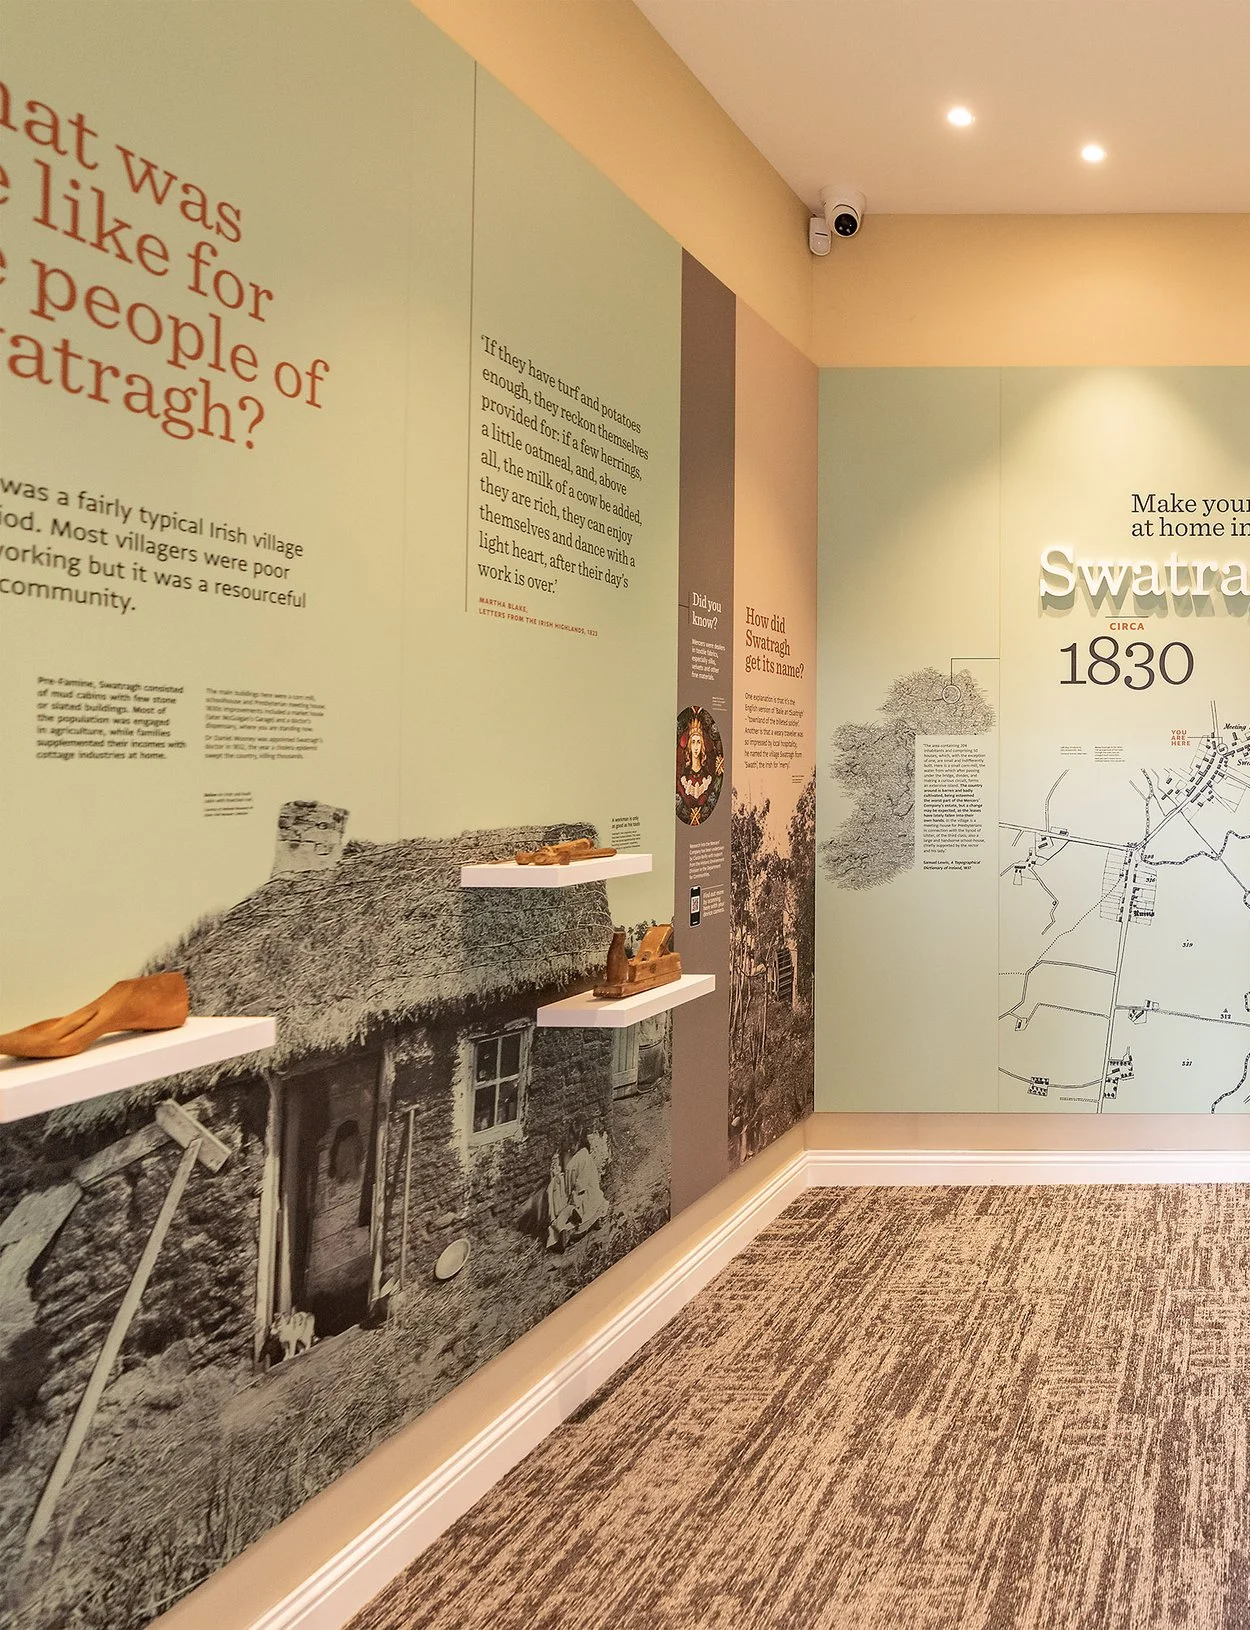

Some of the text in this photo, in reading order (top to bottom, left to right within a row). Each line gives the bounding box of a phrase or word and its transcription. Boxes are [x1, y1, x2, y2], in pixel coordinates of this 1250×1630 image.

[116, 144, 242, 242] was
[32, 158, 274, 322] like for
[30, 256, 260, 382] people
[274, 358, 330, 410] of
[0, 326, 266, 450] atragh?
[481, 334, 641, 434] 'If they have turf and potatoes
[482, 368, 648, 460] enough, they reckon themselves
[481, 395, 642, 482] provided for: if a few herrings,
[481, 422, 627, 496] a little oatmeal, and, above
[0, 478, 304, 560] was a fairly typical Irish village
[1131, 492, 1197, 513] Make
[1132, 520, 1154, 537] at
[1159, 516, 1225, 537] home
[50, 518, 291, 580] Most villagers were poor
[0, 578, 136, 615] community.
[89, 555, 125, 580] but
[132, 562, 148, 583] it
[154, 571, 192, 590] was
[198, 579, 208, 592] a
[214, 582, 306, 608] resourceful
[479, 597, 528, 613] MARTHA BLAKE,
[479, 608, 506, 618] LETTERS
[507, 614, 524, 622] FROM
[526, 617, 537, 625] THE
[538, 620, 553, 628] IRISH
[692, 592, 722, 613] Did you
[692, 611, 718, 630] know?
[745, 607, 786, 634] How did
[745, 629, 790, 658] Swatragh
[1110, 622, 1144, 630] CIRCA
[745, 654, 804, 679] get its name?
[1060, 636, 1194, 690] 1830
[99, 680, 142, 693] Swatragh
[1224, 723, 1246, 731] Meeting
